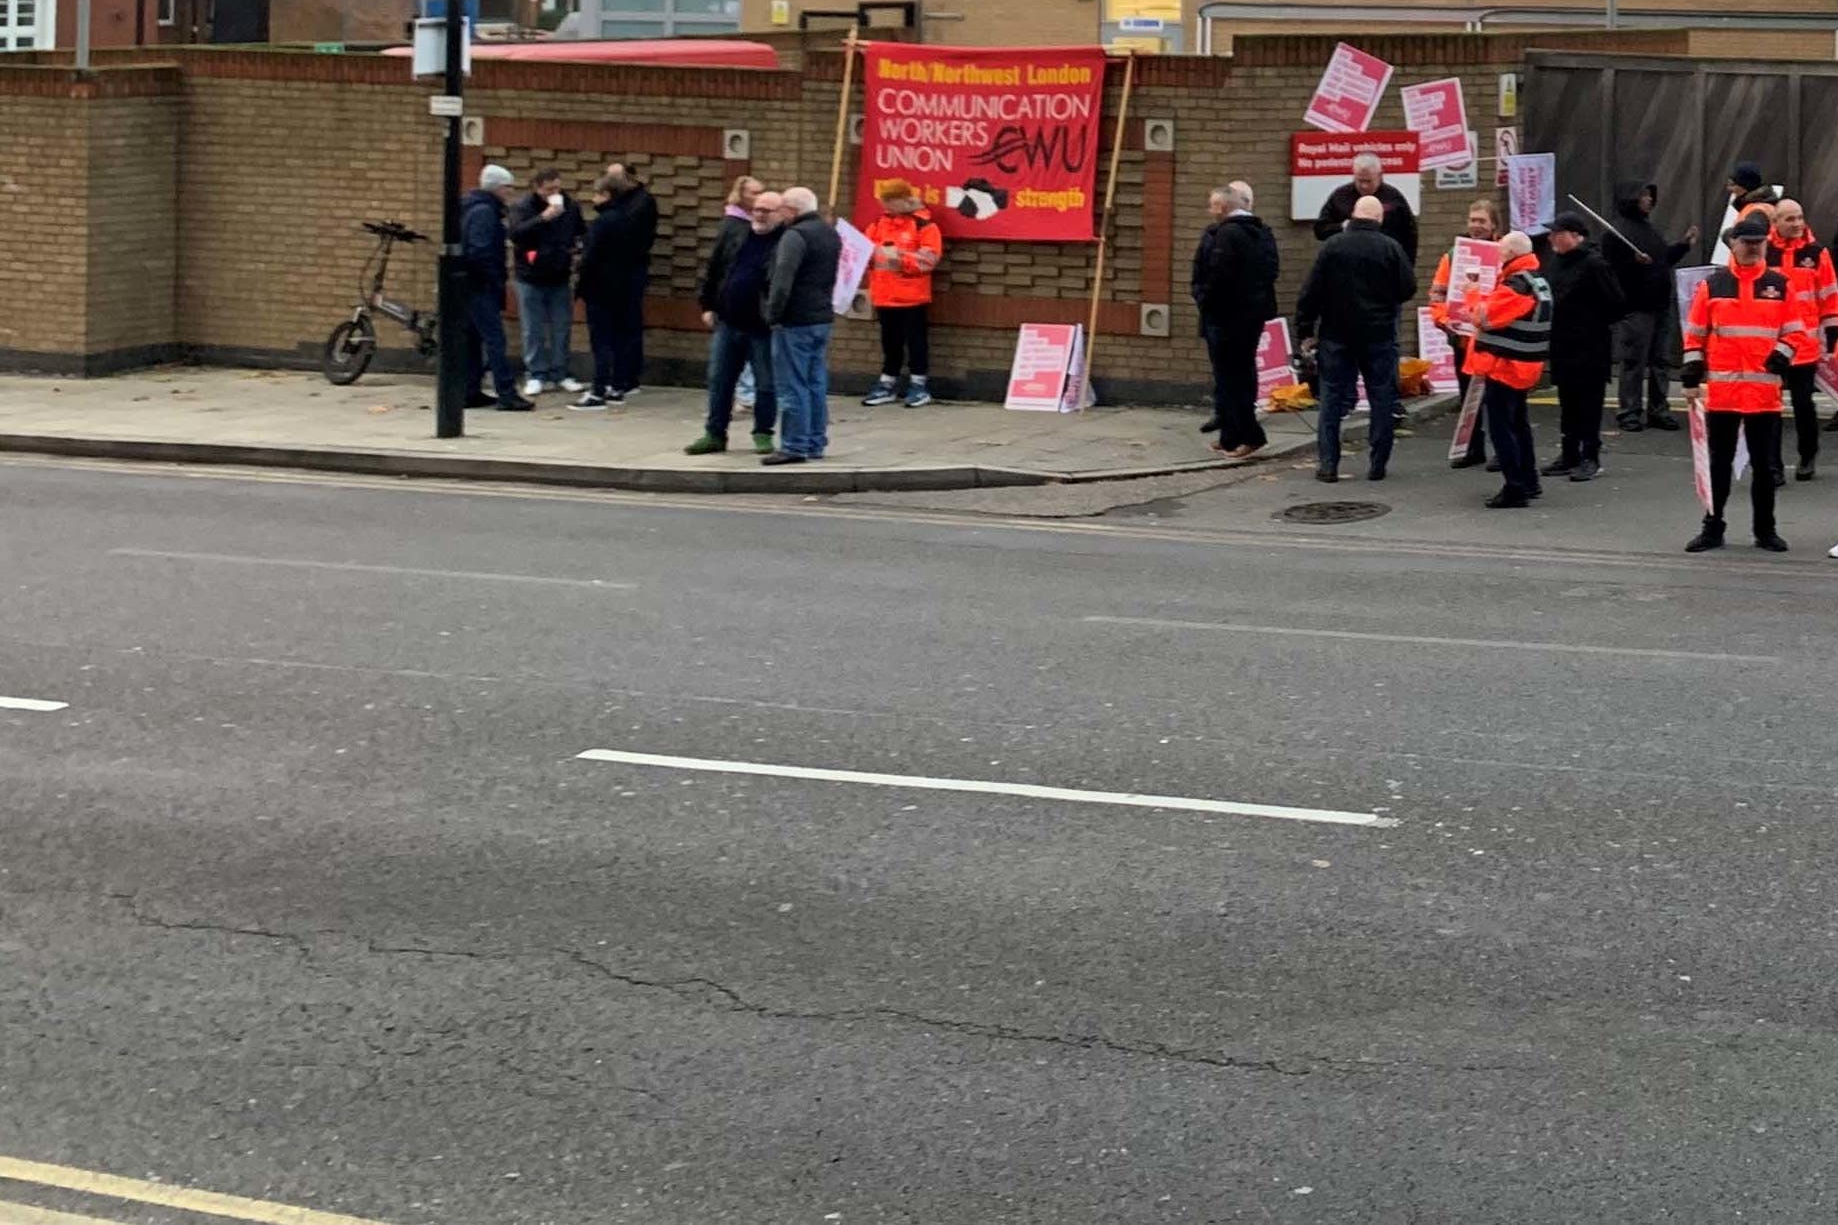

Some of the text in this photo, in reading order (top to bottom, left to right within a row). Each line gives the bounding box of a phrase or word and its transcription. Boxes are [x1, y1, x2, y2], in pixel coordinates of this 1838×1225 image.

[1027, 63, 1091, 85] London
[878, 88, 1091, 120] COMMUNICATION
[878, 118, 988, 146] WORKERS
[876, 145, 953, 171] UNION
[972, 124, 1086, 173] CWU
[1298, 141, 1416, 156] Royal Mail vehicles only
[1298, 157, 1312, 168] No
[924, 184, 940, 205] is
[1015, 186, 1085, 212] strength
